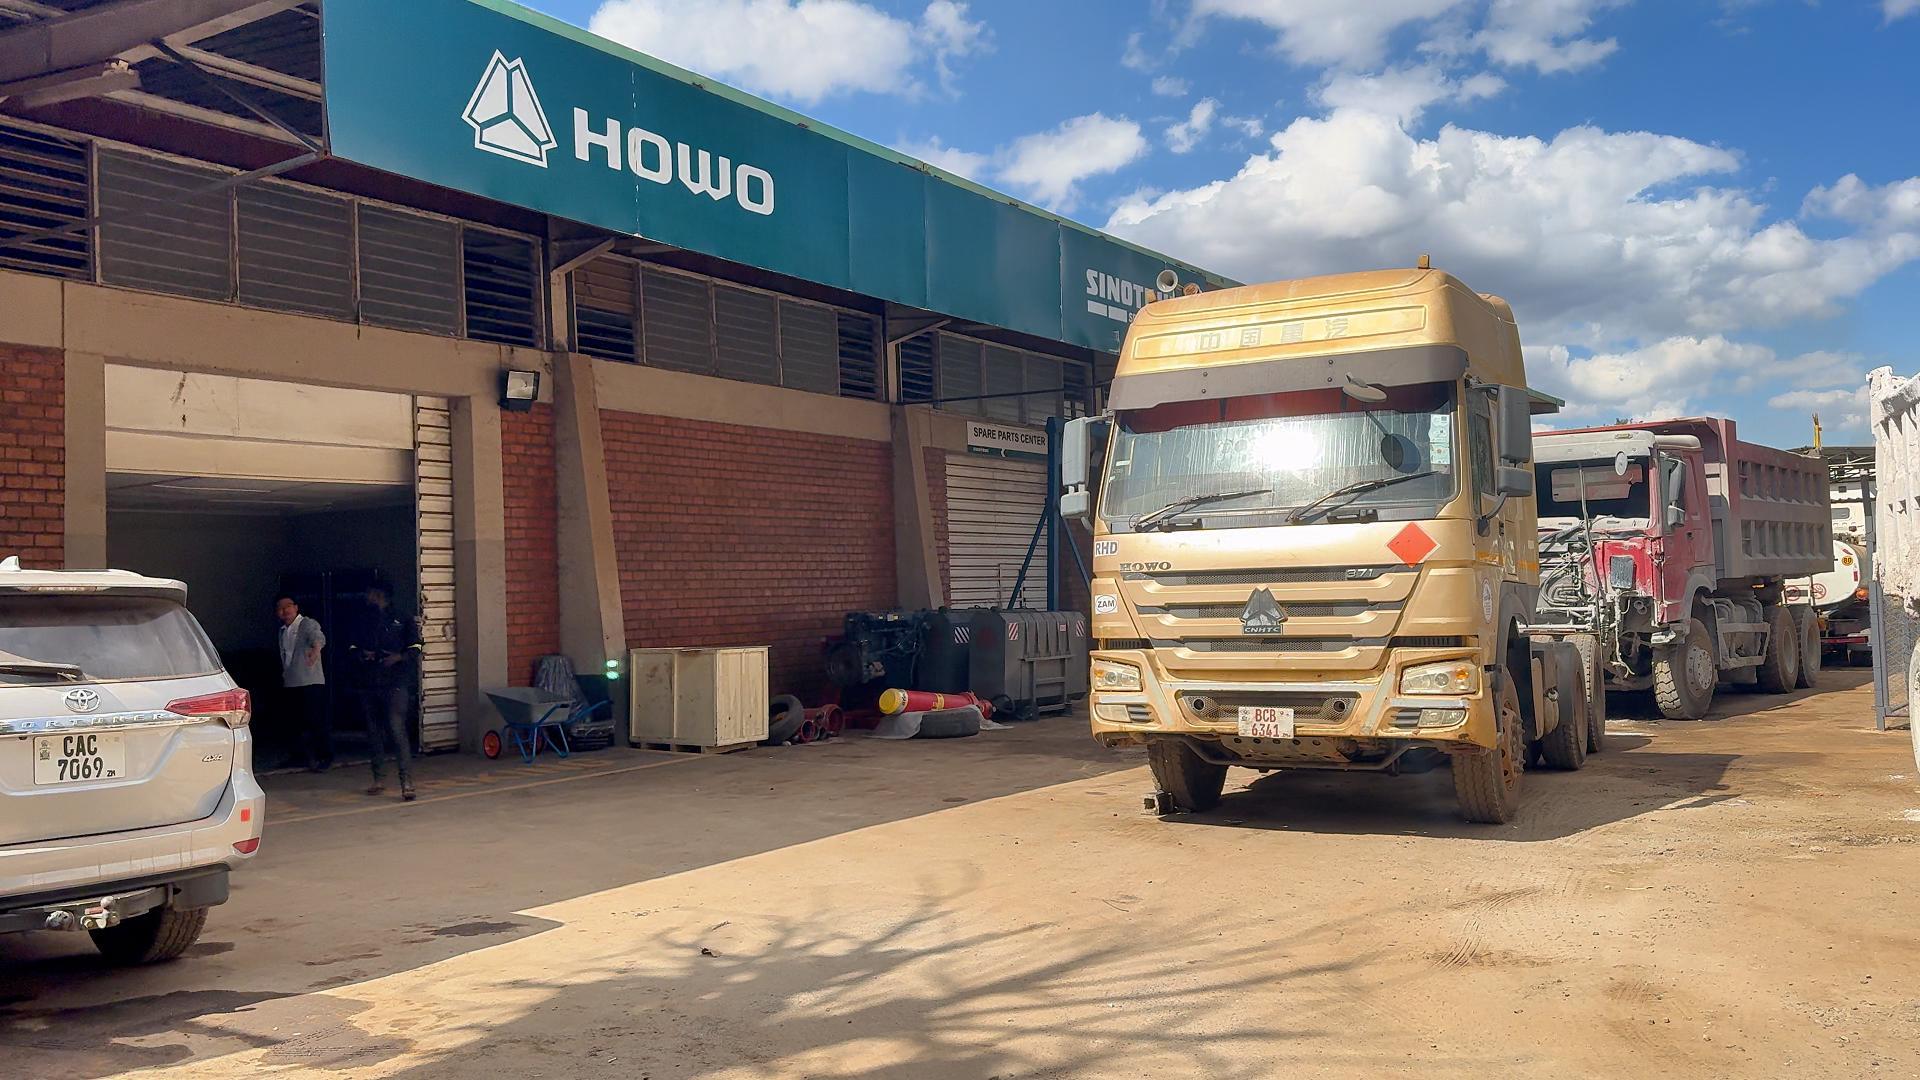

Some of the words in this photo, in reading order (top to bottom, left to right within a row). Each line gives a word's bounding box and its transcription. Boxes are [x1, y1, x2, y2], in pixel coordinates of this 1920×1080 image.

[573, 106, 775, 216] HOWO
[973, 426, 996, 440] SPARE
[998, 430, 1019, 443] PARTS
[1020, 433, 1046, 446] CENTER
[1095, 541, 1118, 556] RHD
[1120, 561, 1172, 571] HOWO
[1346, 568, 1374, 577] 371
[1097, 600, 1115, 608] ZAM
[1244, 626, 1281, 634] CNHTC
[1255, 708, 1276, 722] BCB
[1251, 723, 1279, 737] 6341
[63, 734, 98, 758] CAC
[57, 757, 103, 781] 7069
